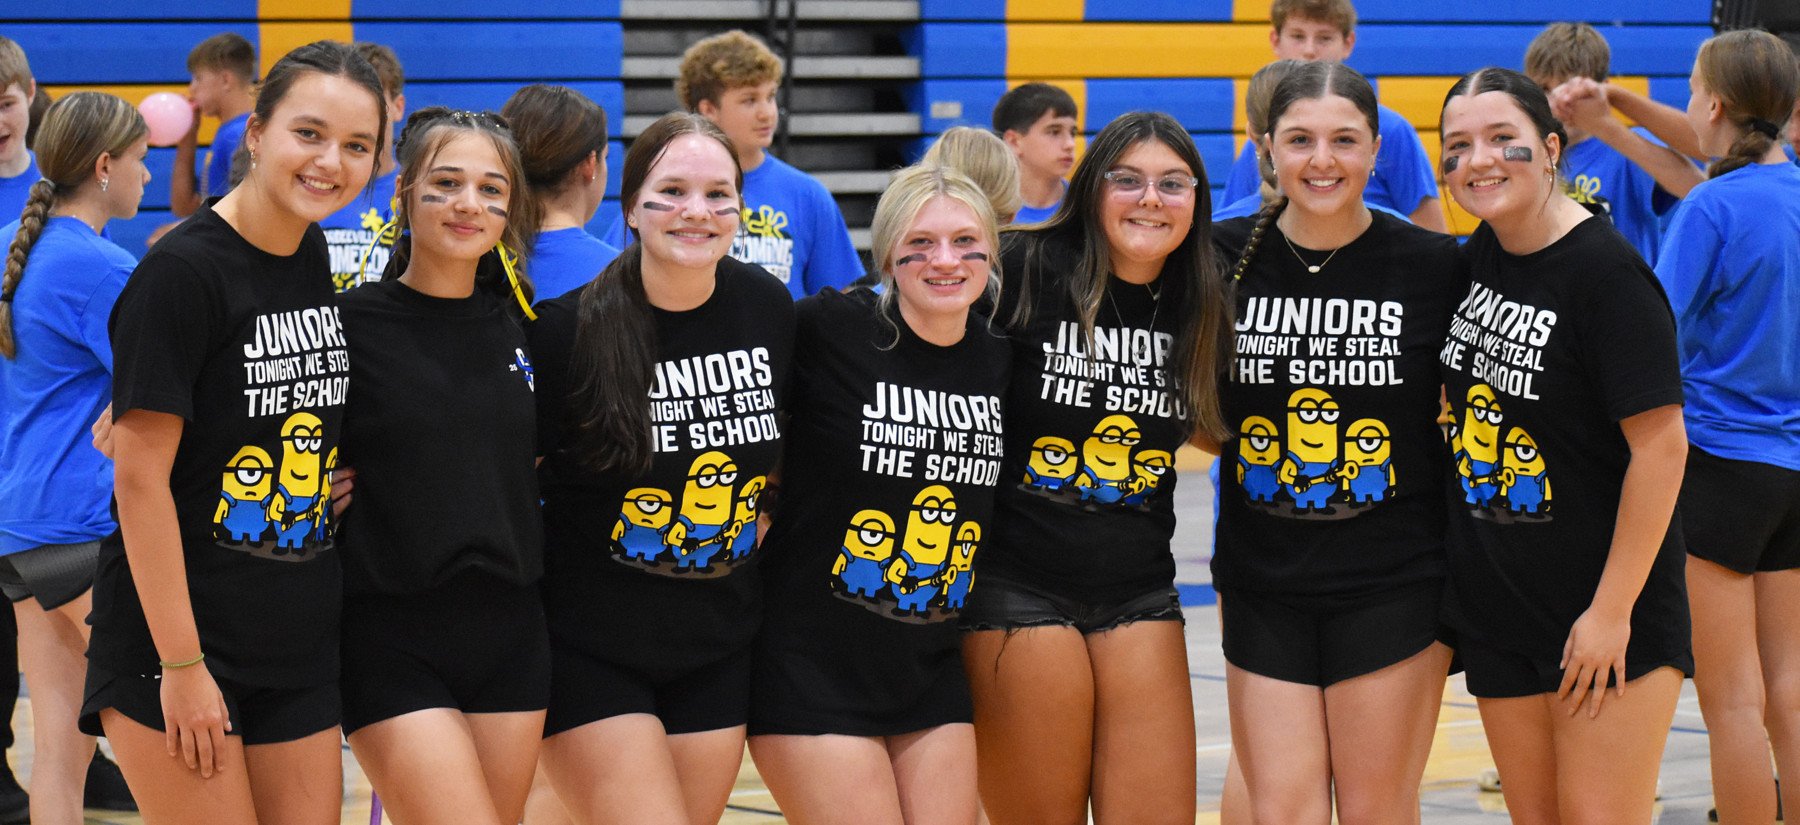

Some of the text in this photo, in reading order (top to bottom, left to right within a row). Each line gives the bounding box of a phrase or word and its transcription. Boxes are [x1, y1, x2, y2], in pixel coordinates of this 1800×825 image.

[1235, 297, 1403, 337] JUNIORS
[1043, 321, 1174, 367] JUNIOR
[1235, 334, 1402, 357] ONIGHT WE STEAL
[1483, 332, 1503, 357] WE
[1501, 340, 1545, 372] STEAL
[244, 356, 301, 384] TONIGHT
[305, 352, 326, 376] WE
[648, 347, 772, 399] UNIORS
[1120, 366, 1149, 386] WE
[1289, 359, 1403, 386] SCHOOL
[1472, 352, 1540, 401] SCHOOL
[244, 385, 289, 417] THE
[649, 400, 694, 422] NIGHT
[700, 395, 730, 418] WE
[863, 382, 1003, 434] JUNIORS
[1041, 373, 1188, 421] THE SCHOO
[689, 413, 780, 450] SCHOOL
[862, 420, 936, 449] TONIGHT
[943, 430, 968, 453] WE
[860, 444, 915, 478] THE
